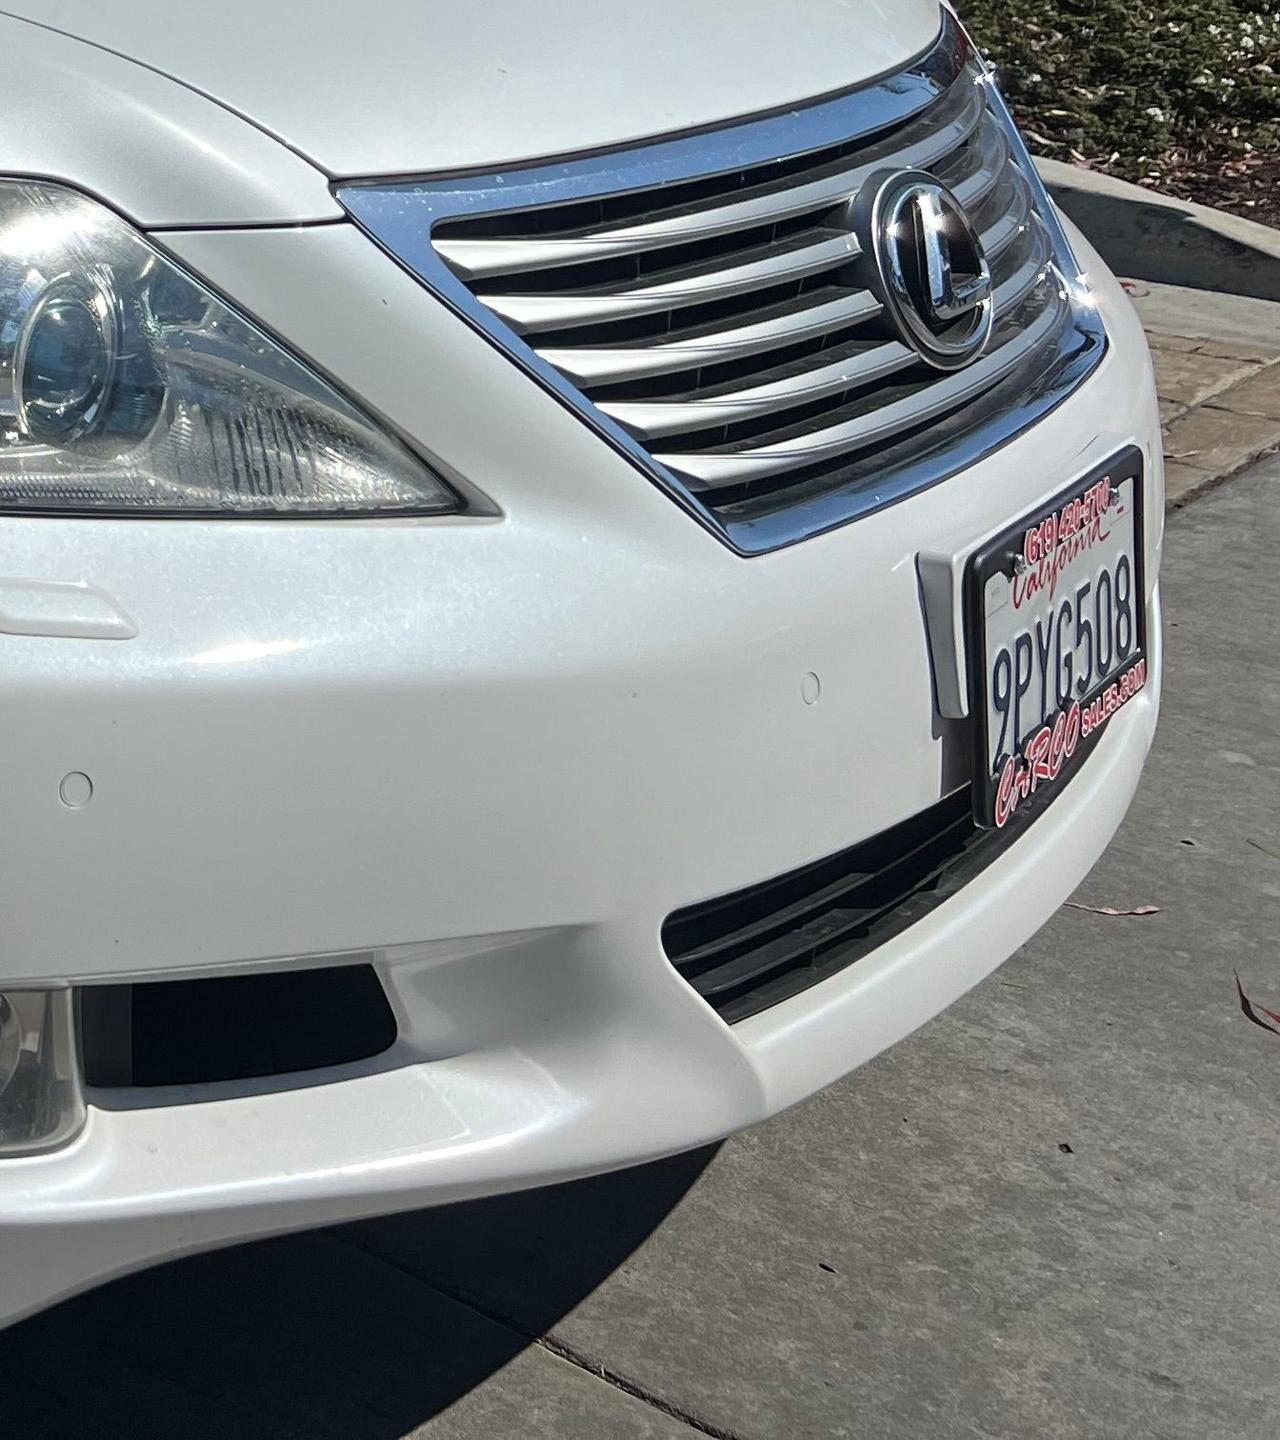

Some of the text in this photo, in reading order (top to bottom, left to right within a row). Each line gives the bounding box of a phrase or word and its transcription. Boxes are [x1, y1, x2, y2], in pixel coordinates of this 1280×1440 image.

[1012, 516, 1111, 609] California
[1023, 475, 1110, 567] (619) 420-5700
[992, 554, 1131, 772] 9PYG508
[995, 658, 1146, 828] CARCO SALES.COM
